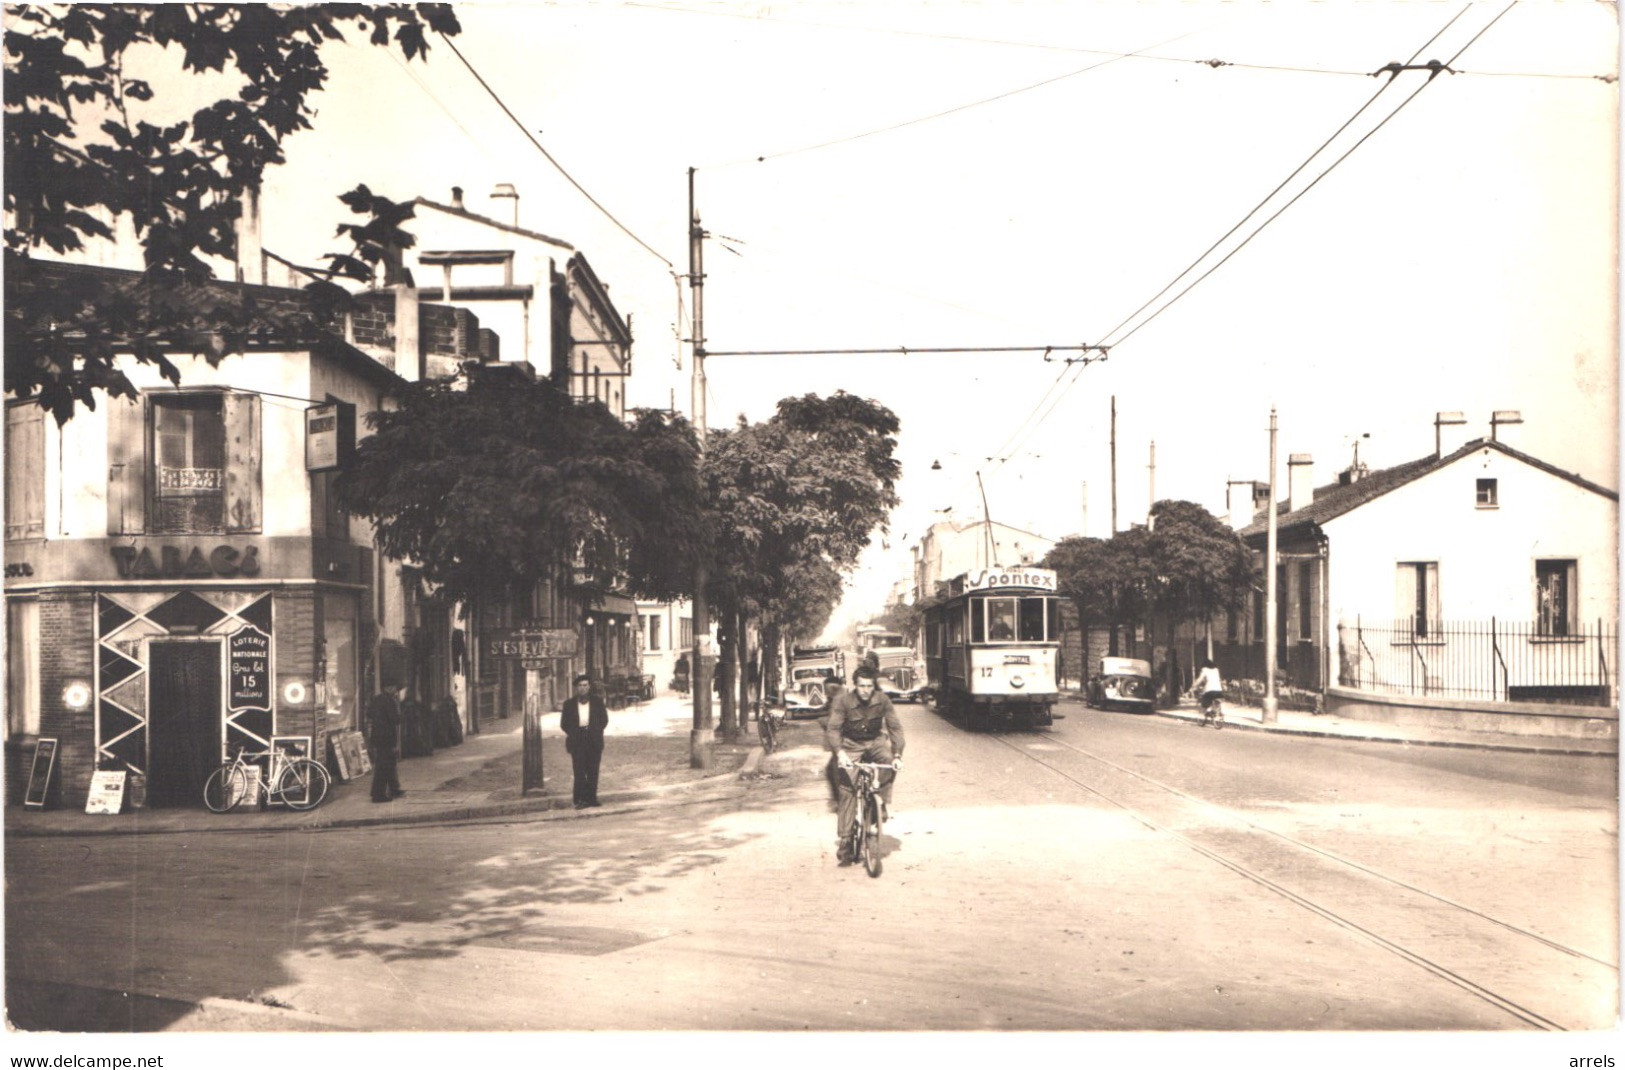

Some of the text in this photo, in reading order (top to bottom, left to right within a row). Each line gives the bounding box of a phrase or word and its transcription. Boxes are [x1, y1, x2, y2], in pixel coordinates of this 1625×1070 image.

[110, 545, 260, 577] TABACS
[970, 569, 1053, 588] Spontex
[233, 637, 266, 647] LOTERIE
[233, 661, 264, 675] Gros lot
[981, 667, 993, 677] 17
[242, 676, 256, 687] 15
[235, 688, 262, 698] millions
